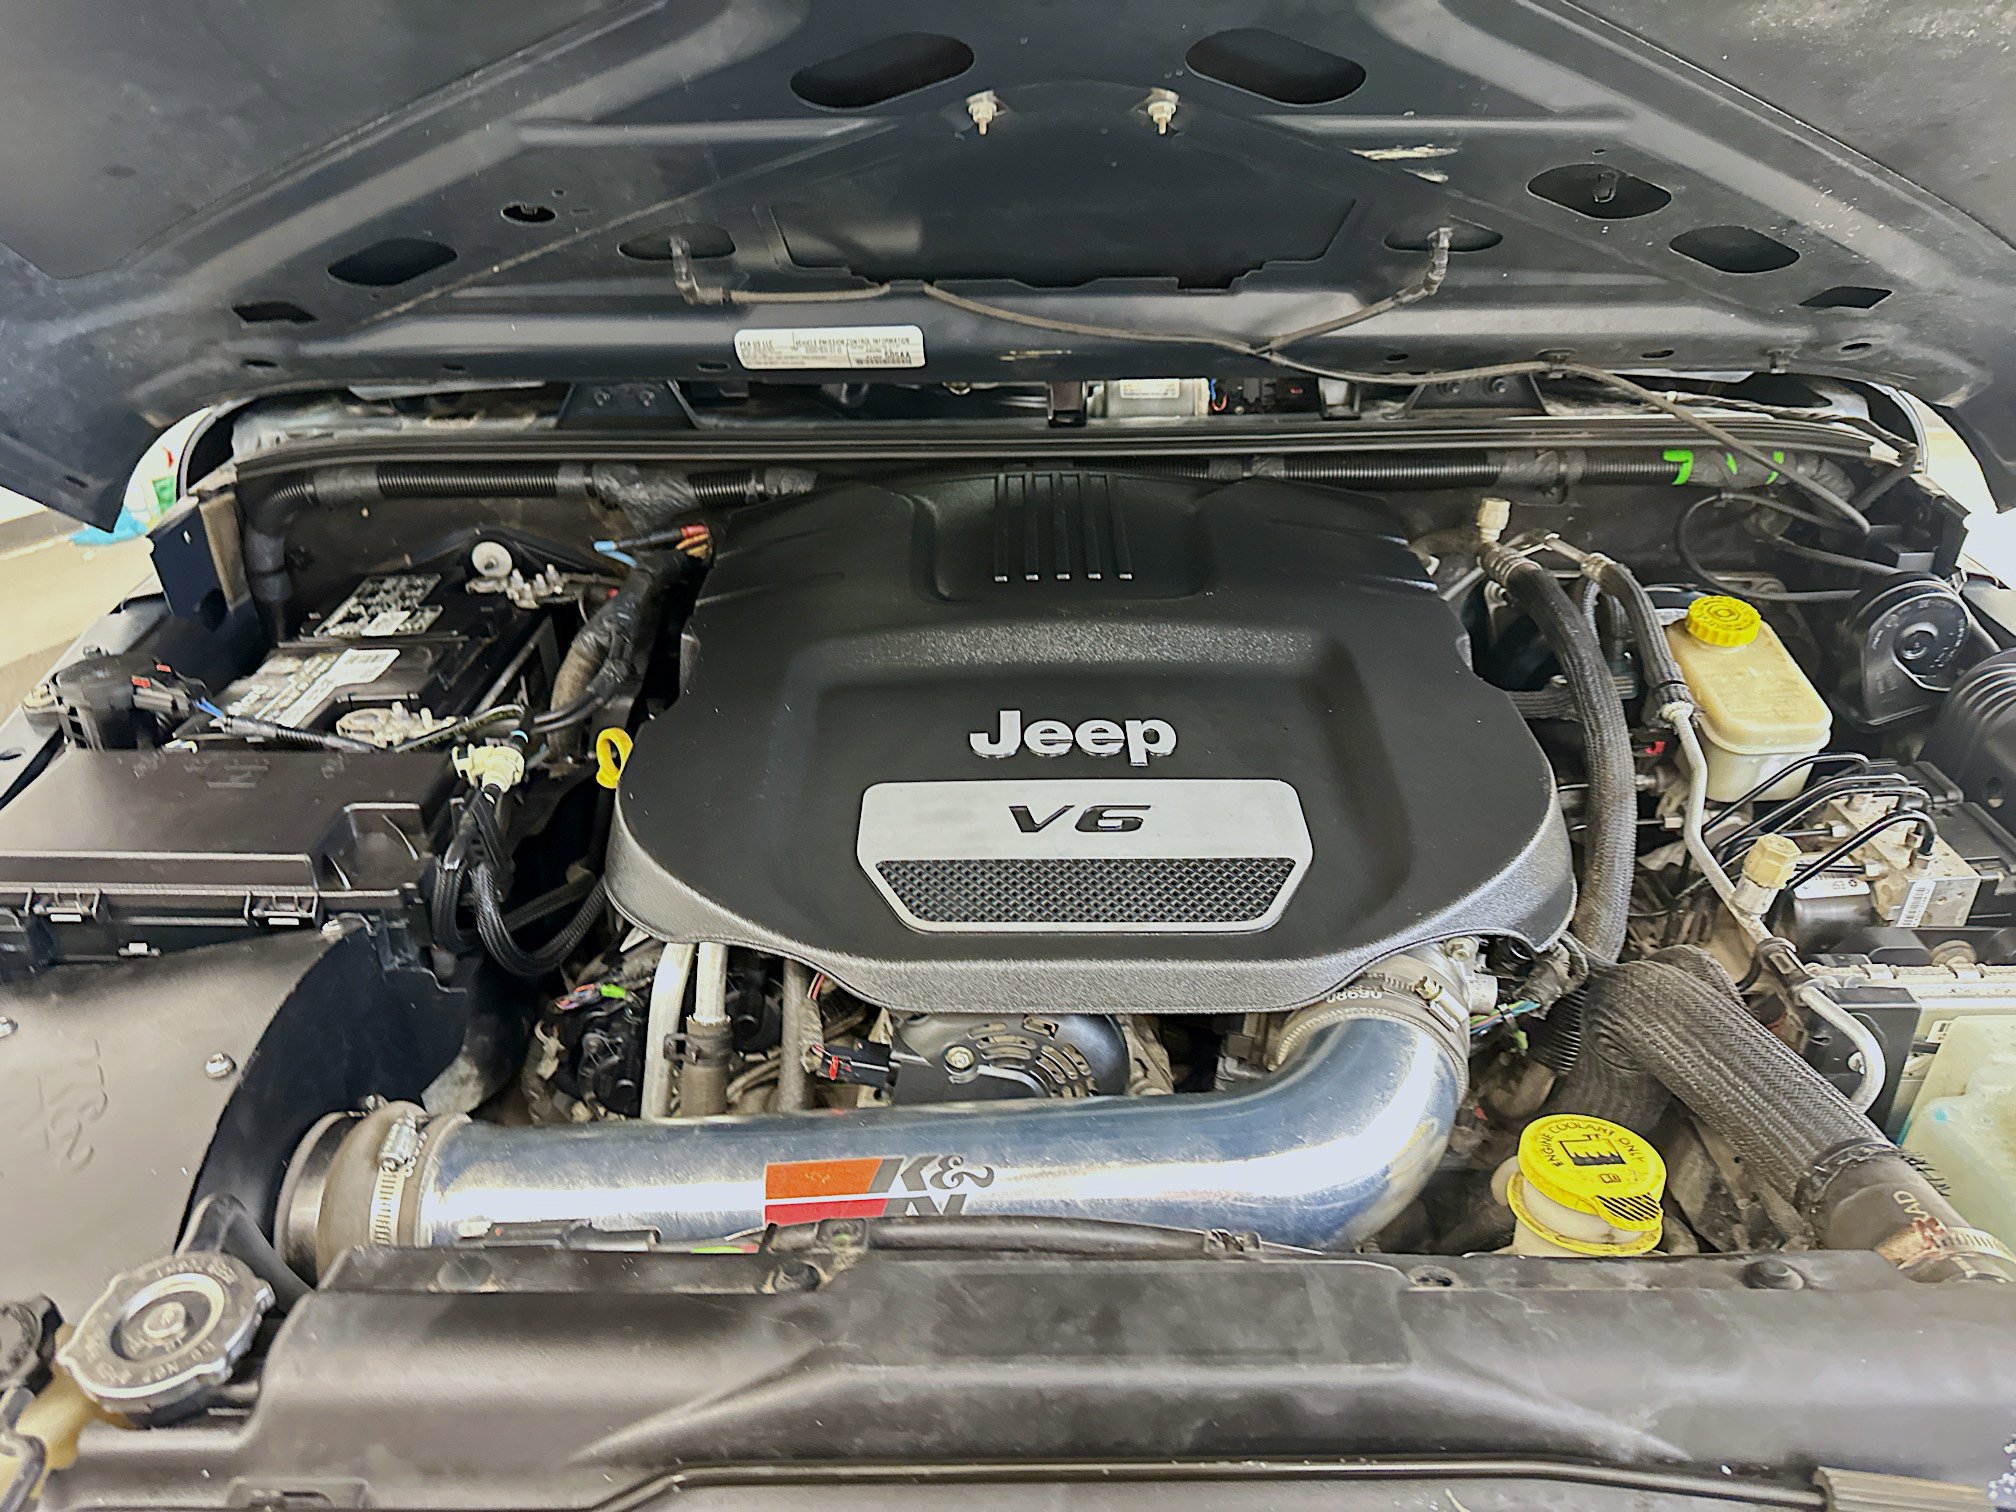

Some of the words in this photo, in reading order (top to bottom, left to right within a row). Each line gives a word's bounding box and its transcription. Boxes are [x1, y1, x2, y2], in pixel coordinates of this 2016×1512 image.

[819, 338, 846, 346] EMISSION
[872, 337, 910, 345] INFORMATION
[969, 709, 1177, 766] Jeep
[1008, 805, 1151, 833] V6
[1549, 1121, 1615, 1136] COOLANT
[1540, 1133, 1564, 1167] ENGINE
[1618, 1137, 1645, 1162] ONLY
